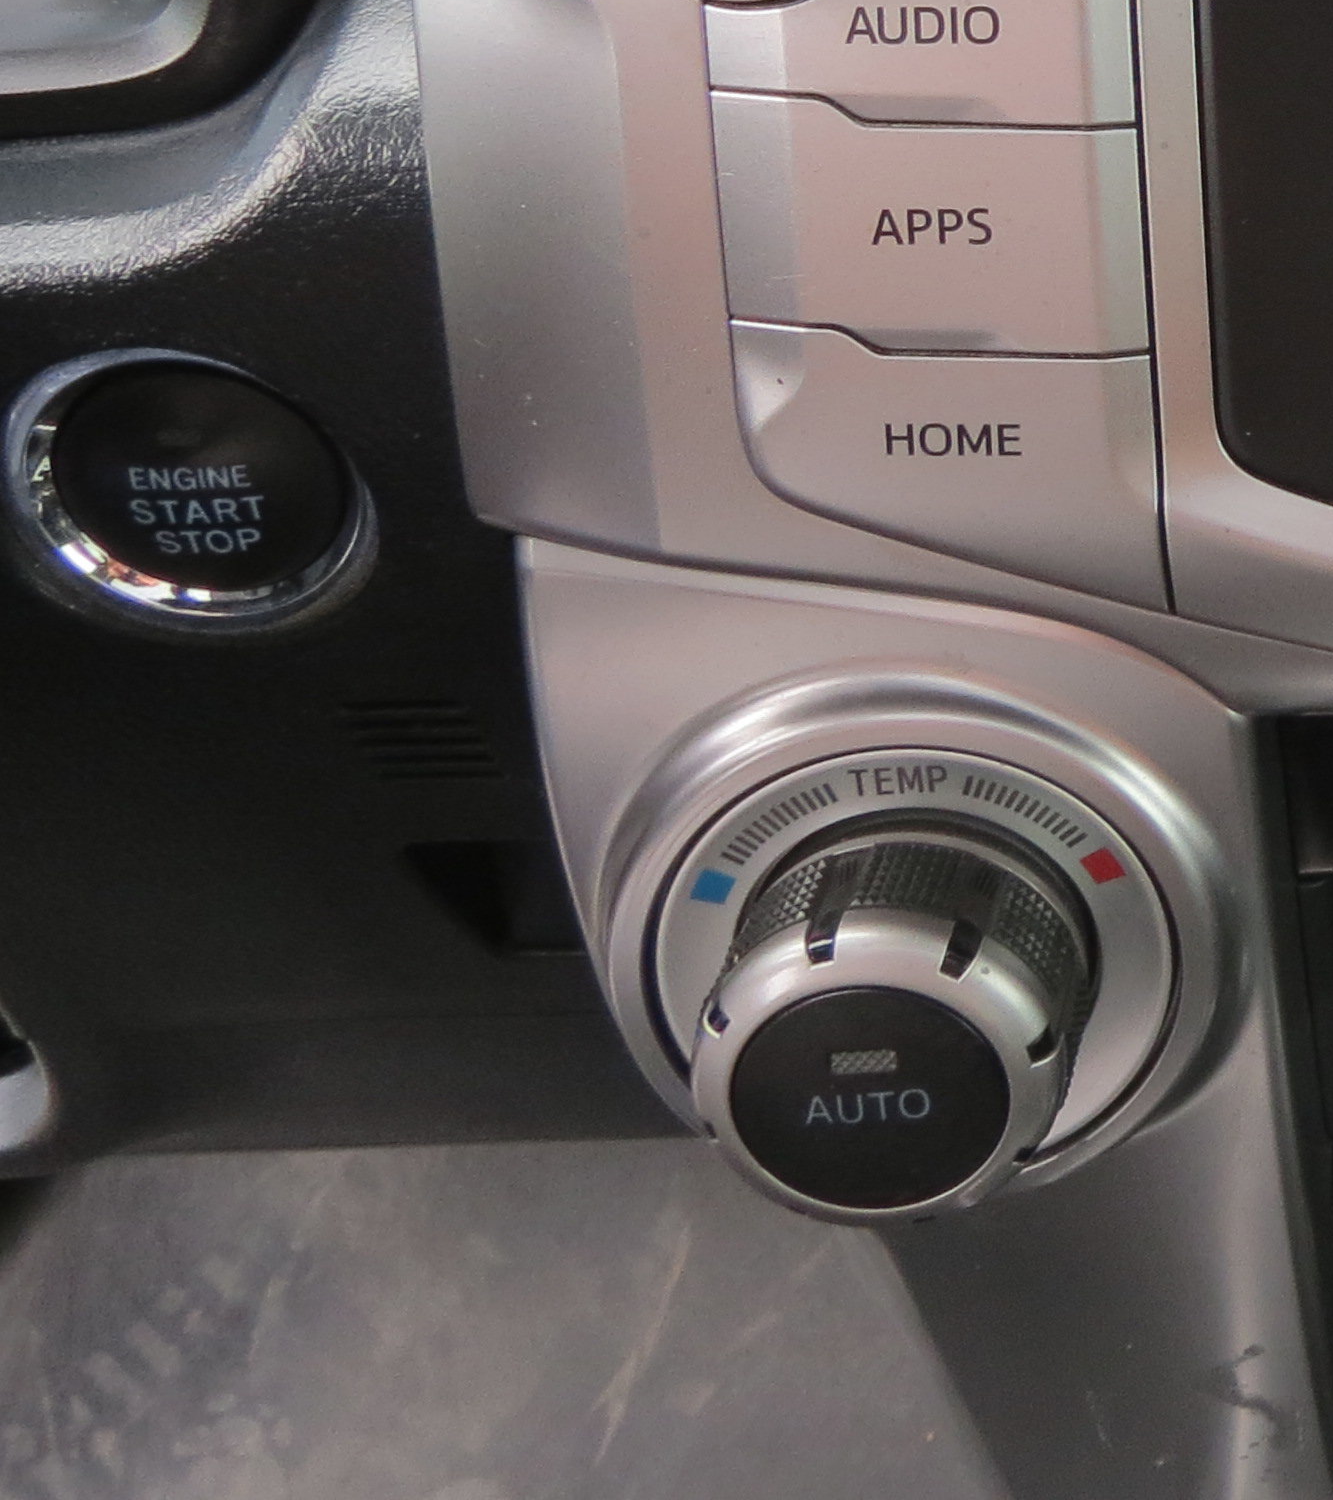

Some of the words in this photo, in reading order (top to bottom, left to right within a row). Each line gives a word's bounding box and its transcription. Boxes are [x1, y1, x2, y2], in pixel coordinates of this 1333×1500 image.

[845, 5, 1000, 45] AUDIO
[871, 208, 993, 245] APPS
[884, 423, 1022, 457] HOME
[128, 464, 252, 491] ENGINE
[128, 495, 264, 525] START
[155, 528, 261, 554] STOP
[846, 764, 949, 798] TEMP
[804, 1087, 932, 1126] AUTO
